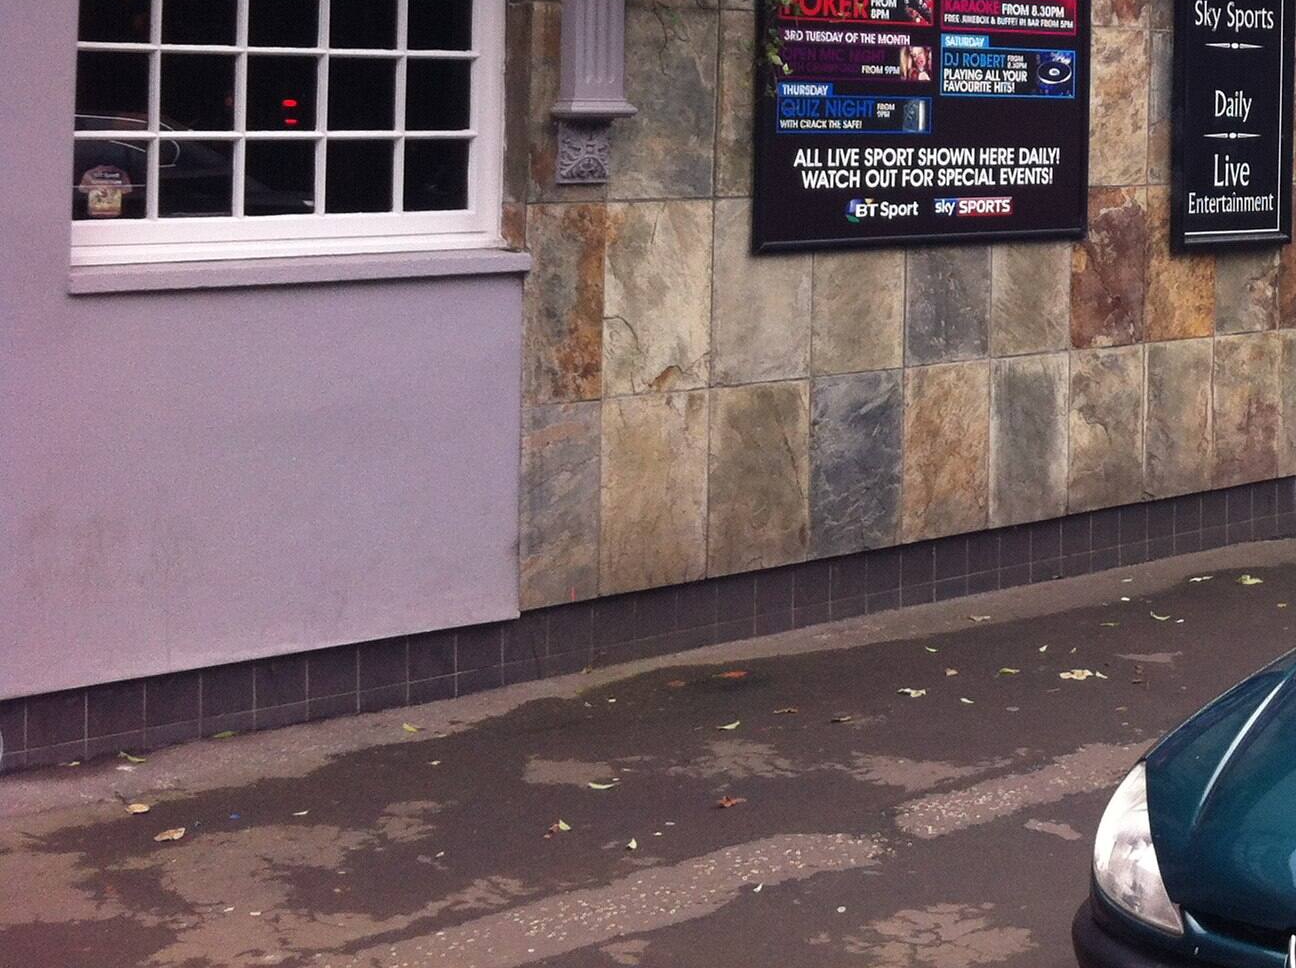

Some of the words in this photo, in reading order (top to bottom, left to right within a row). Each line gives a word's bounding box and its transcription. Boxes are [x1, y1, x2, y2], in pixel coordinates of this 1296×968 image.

[871, 9, 890, 20] 8PM
[1001, 3, 1029, 16] FROM
[1031, 5, 1065, 18] 8.30PM
[1194, 0, 1221, 32] Sky
[1227, 1, 1274, 32] Sports
[1041, 19, 1059, 28] FROM
[784, 30, 803, 41] 3RD
[805, 31, 843, 43] TUESDAY
[845, 32, 859, 44] OF
[860, 33, 875, 44] THE
[878, 34, 910, 45] MONTH
[945, 35, 985, 47] SATURDAY
[944, 53, 959, 67] DJ
[962, 53, 1006, 68] ROBERT
[862, 66, 883, 74] FROM
[944, 68, 983, 81] PLAYING
[985, 70, 1001, 81] ALL
[1002, 71, 1027, 82] YOUR
[782, 84, 828, 96] THURSDAY
[943, 80, 992, 92] FAVOURITE
[994, 82, 1015, 93] HITS!
[781, 99, 820, 117] QUIZ
[825, 99, 875, 117] NIGHT
[1215, 90, 1252, 122] Daily
[780, 120, 798, 129] WITH
[800, 120, 827, 129] CRACK
[828, 120, 841, 129] THE
[793, 149, 822, 167] ALL
[828, 149, 859, 167] LIVE
[864, 148, 914, 167] SPORT
[918, 148, 975, 166] SHOWN
[979, 148, 1015, 166] HERE
[1018, 147, 1060, 165] DAILY!
[801, 170, 860, 189] WATCH
[865, 169, 898, 188] OUT
[901, 169, 934, 187] FOR
[937, 168, 995, 186] SPECIAL
[999, 167, 1053, 185] EVENTS!
[1214, 154, 1250, 187] Live
[855, 203, 878, 217] BT
[880, 201, 918, 219] Sport
[935, 200, 956, 216] sky
[959, 199, 1011, 214] SPORTS
[1188, 192, 1274, 214] Entertainment
